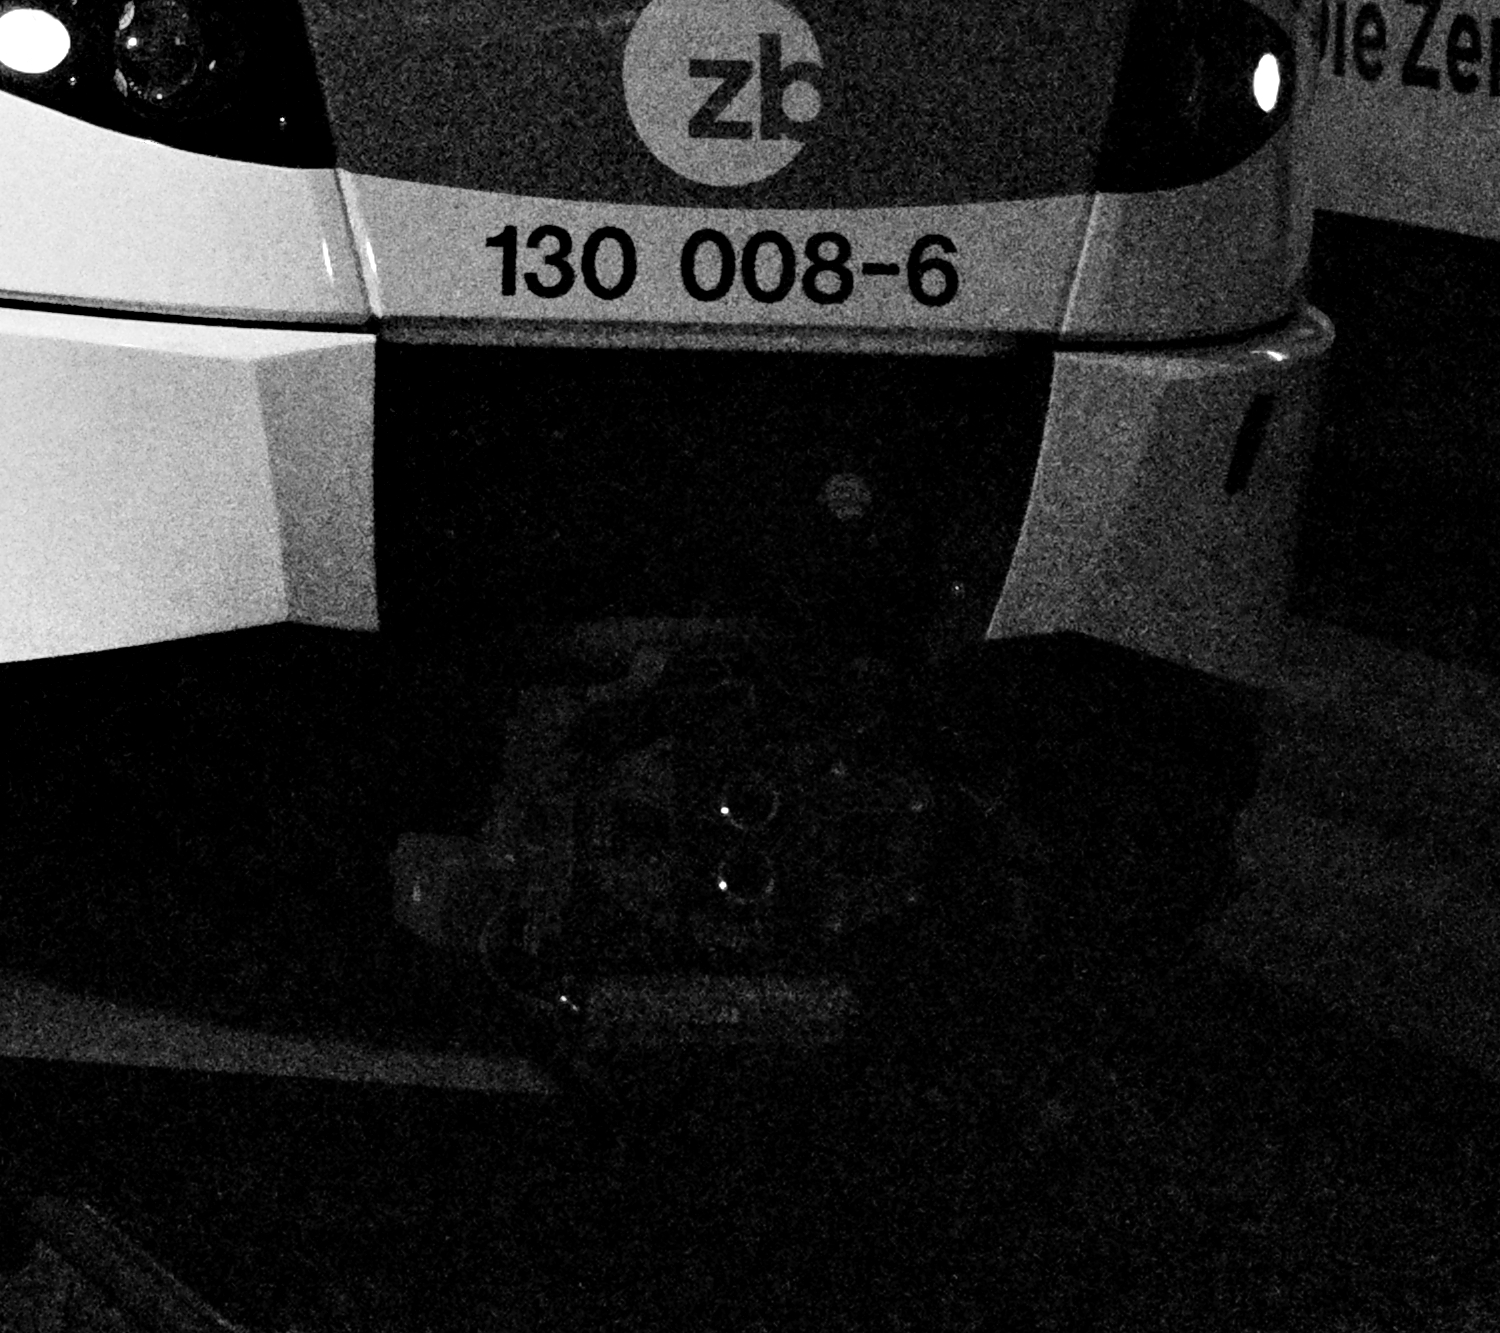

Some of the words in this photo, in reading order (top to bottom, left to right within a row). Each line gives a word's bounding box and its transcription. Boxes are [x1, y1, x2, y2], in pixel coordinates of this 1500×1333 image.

[687, 32, 832, 142] zb
[485, 224, 638, 301] 130
[679, 227, 961, 307] 008-6
